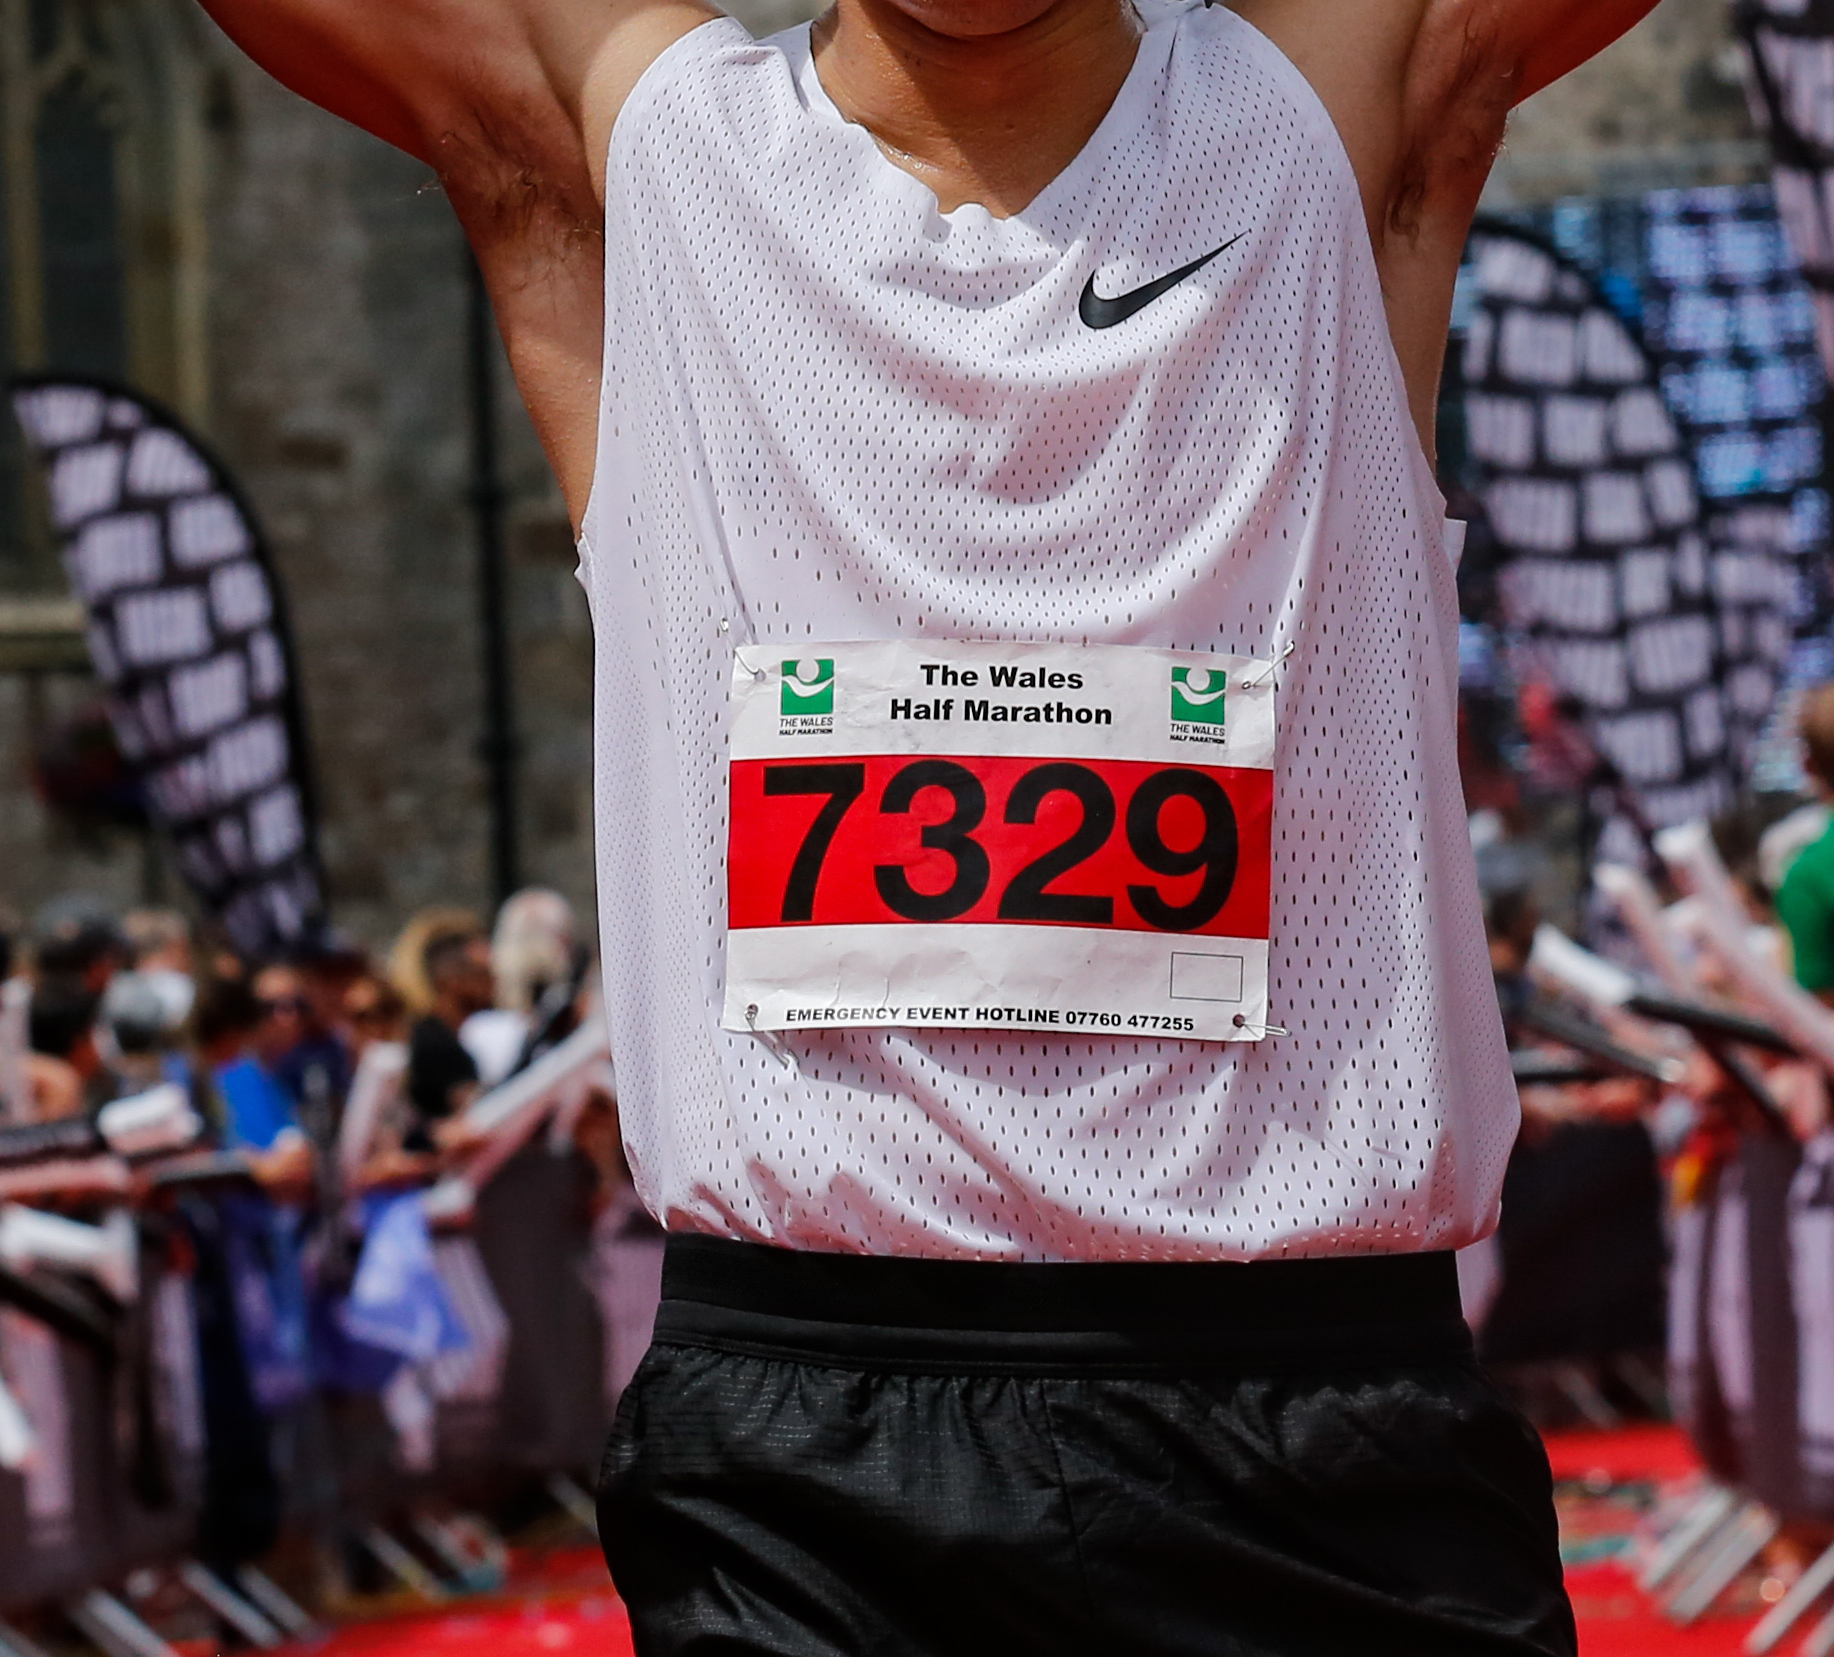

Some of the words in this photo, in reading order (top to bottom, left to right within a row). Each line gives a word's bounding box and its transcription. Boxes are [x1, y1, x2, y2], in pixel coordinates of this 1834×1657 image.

[919, 664, 980, 688] The
[989, 666, 1084, 690] Wales
[779, 718, 798, 728] THE
[800, 717, 834, 727] WALES
[889, 698, 954, 722] Half
[962, 699, 1113, 726] Marathon
[1170, 723, 1190, 734] THE
[1192, 725, 1226, 737] WALES
[762, 759, 1239, 932] 7329
[785, 1007, 902, 1023] EMERGENCY
[906, 1007, 970, 1021] EVENT
[975, 1008, 1060, 1024] HOTLINE
[1065, 1011, 1122, 1026] 07760
[1127, 1015, 1195, 1032] 477255
